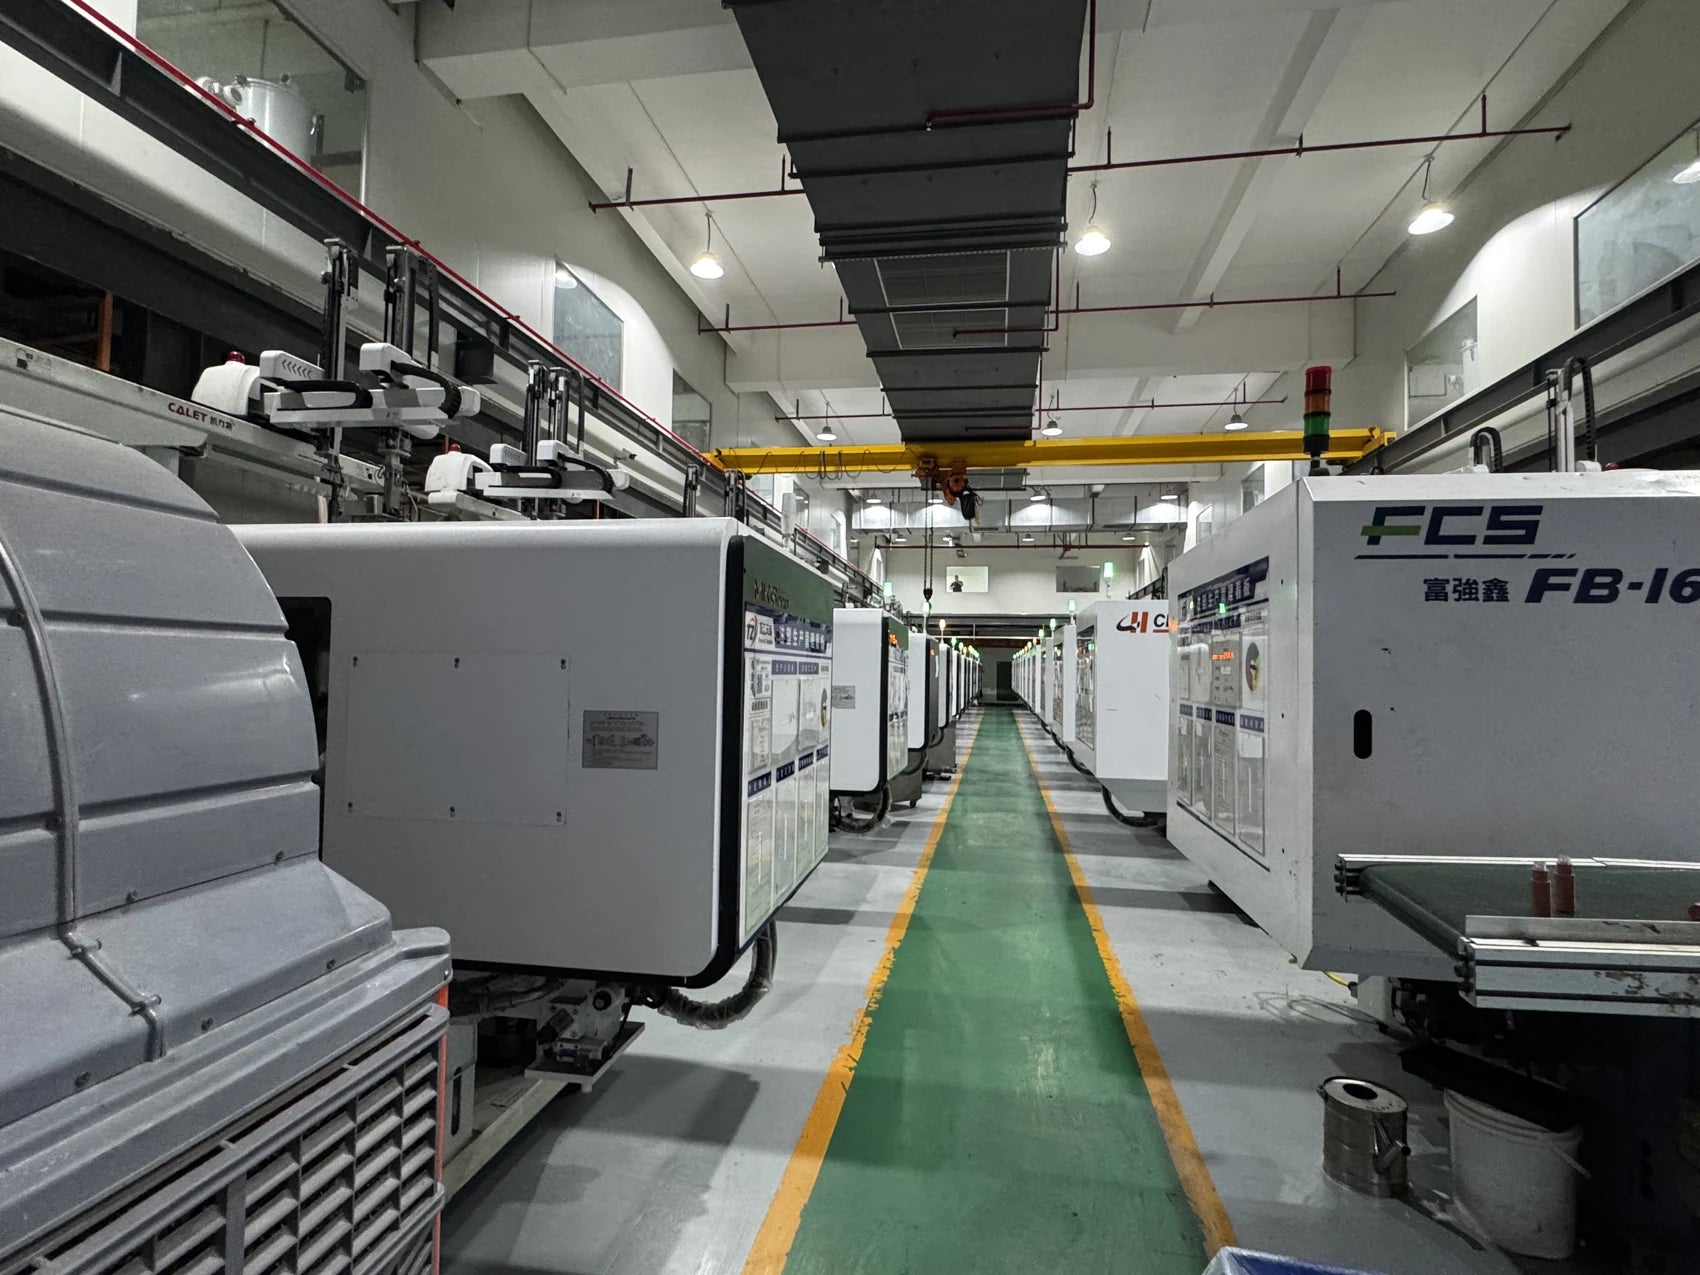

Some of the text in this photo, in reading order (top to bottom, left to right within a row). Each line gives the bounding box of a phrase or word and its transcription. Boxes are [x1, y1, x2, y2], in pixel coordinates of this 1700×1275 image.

[168, 402, 208, 423] CALET
[1360, 505, 1543, 545] FCS
[1423, 577, 1510, 603] 富強鑫
[1153, 613, 1169, 628] C
